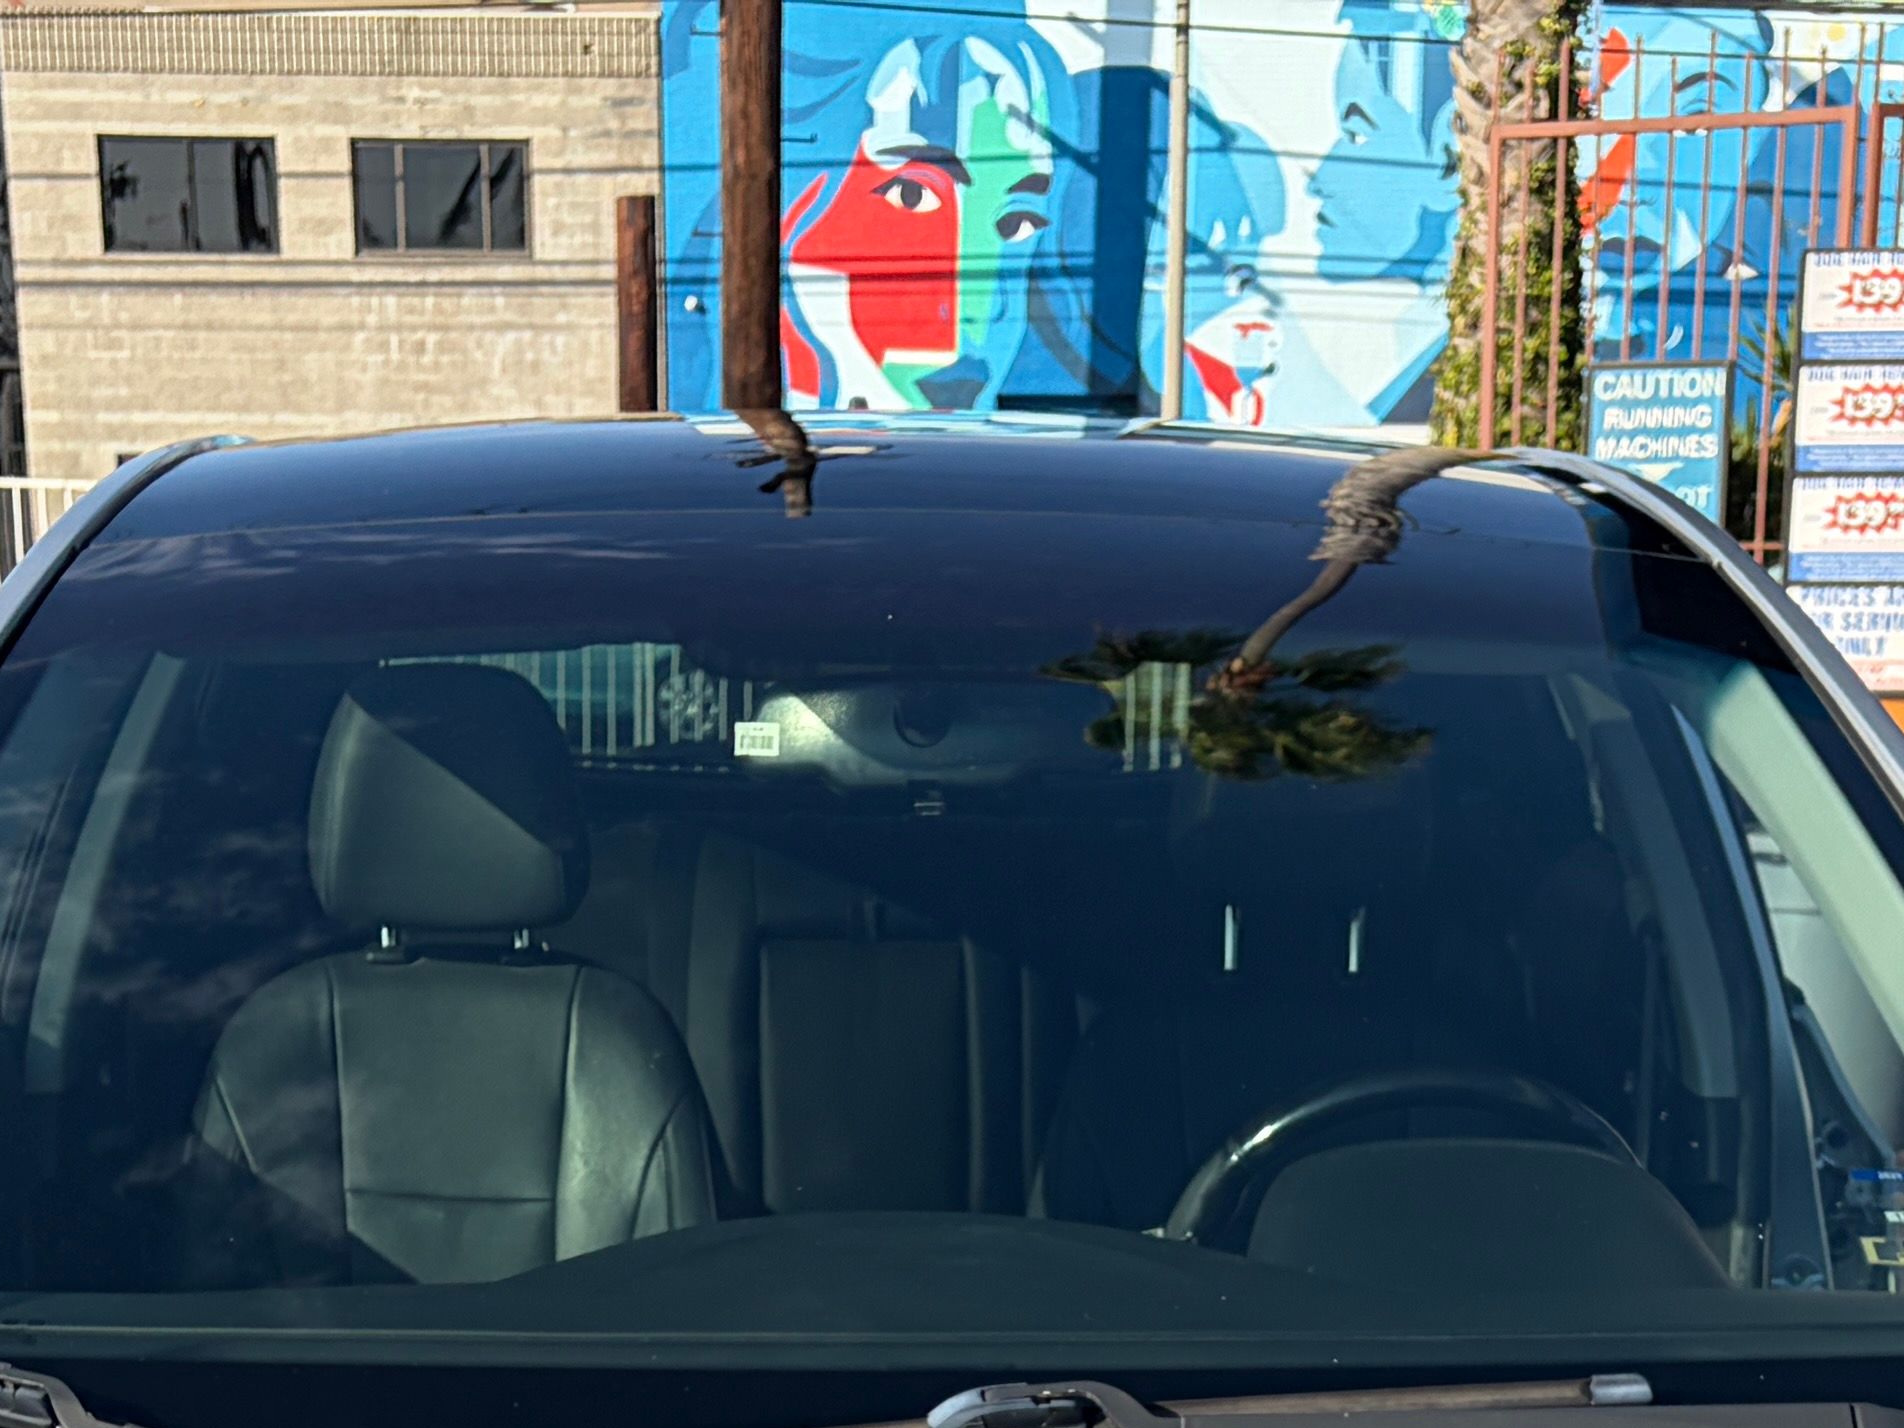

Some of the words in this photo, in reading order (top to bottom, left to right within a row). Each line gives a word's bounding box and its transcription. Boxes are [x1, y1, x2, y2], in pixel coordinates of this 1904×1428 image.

[1594, 369, 1727, 400] CAUTION
[1603, 404, 1713, 431] RUNNING
[1595, 433, 1719, 461] MACHINES
